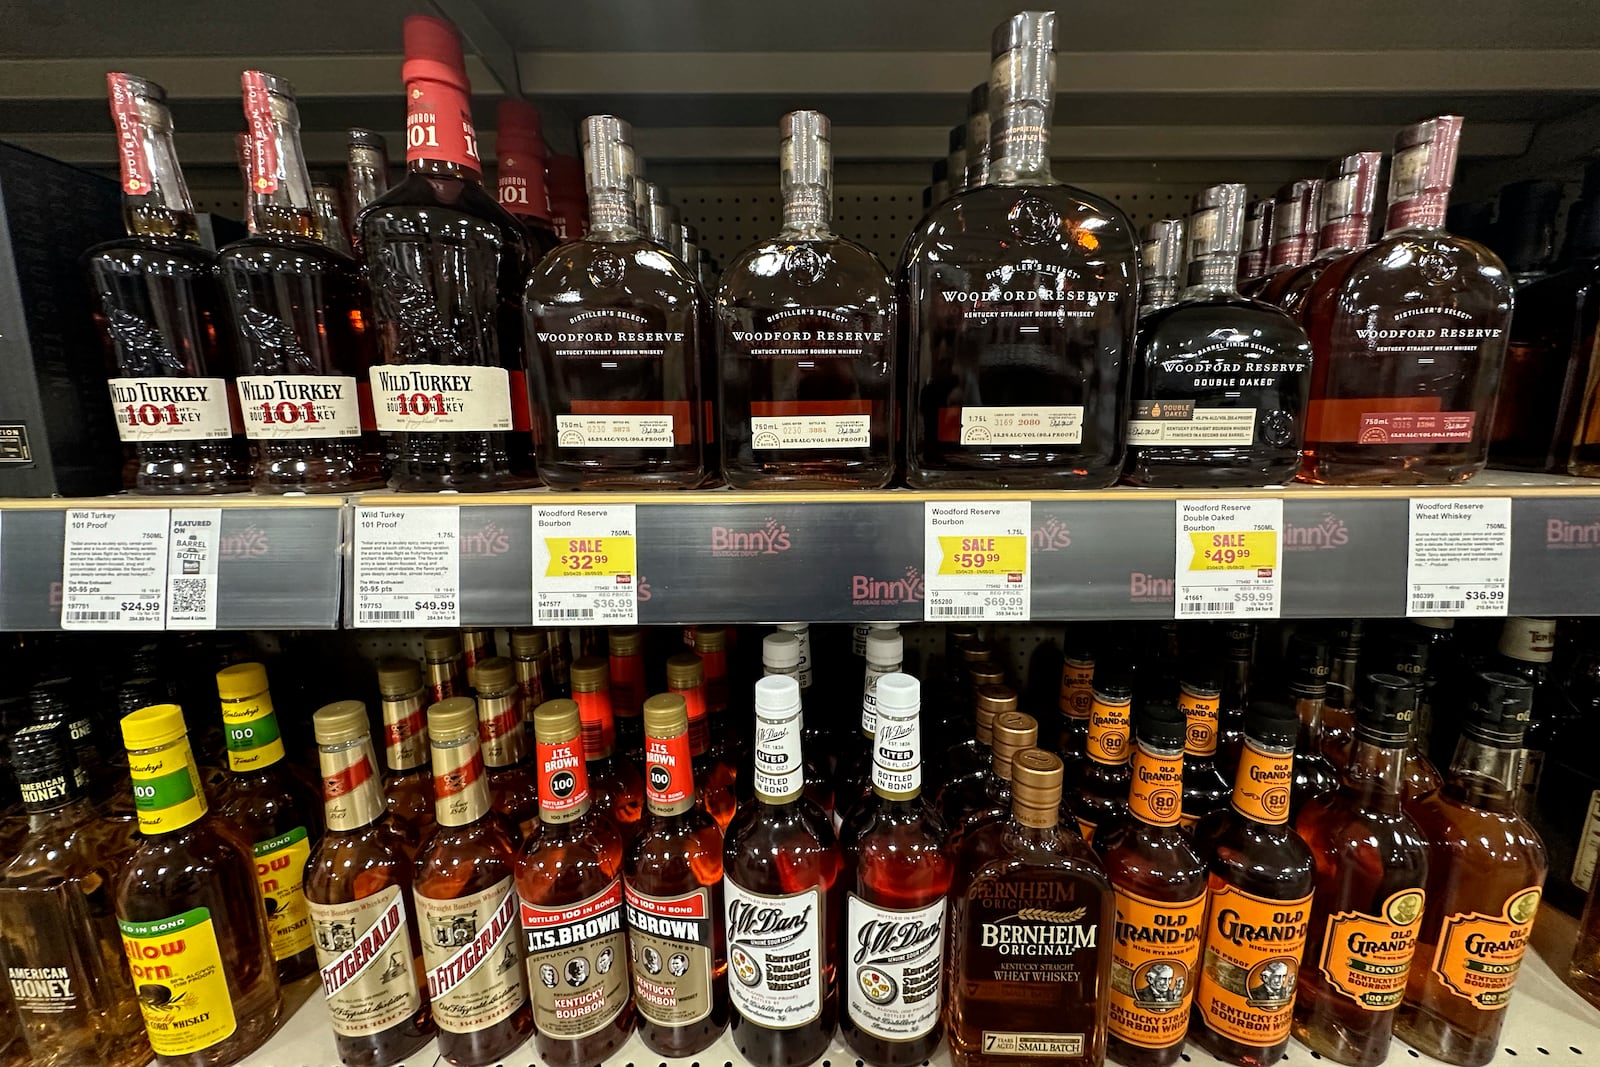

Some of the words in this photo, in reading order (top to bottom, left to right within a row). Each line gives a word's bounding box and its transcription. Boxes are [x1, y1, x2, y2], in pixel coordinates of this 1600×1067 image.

[499, 186, 528, 204] 101
[942, 291, 1037, 302] WOODFORD
[1046, 291, 1118, 302] RESERVE
[570, 310, 614, 325] DISTILLER'S
[767, 309, 814, 323] DISTILLER'S
[1394, 307, 1441, 321] DISTILLER'S
[537, 332, 612, 342] WOODFORD
[618, 332, 684, 342] RESERVE
[732, 331, 811, 341] WOODFORD
[817, 331, 883, 341] RESERVE
[1356, 329, 1435, 338] WOODFORD
[1440, 329, 1502, 338] RESERVE
[1198, 343, 1224, 355] BARREL
[1250, 343, 1274, 355] SELECT
[1162, 363, 1241, 372] WOODFORD
[1246, 363, 1305, 372] RESERVE
[379, 372, 409, 391] WILD
[409, 372, 473, 392] TURKEY
[1240, 378, 1275, 386] OAKED
[108, 383, 137, 401] WILD
[136, 383, 210, 403] TURKEY
[241, 381, 273, 401] WILD
[273, 380, 344, 401] TURKEY
[397, 393, 448, 415] 101
[125, 404, 183, 426] 101
[260, 401, 320, 424] 101
[91, 512, 116, 520] Turkey
[569, 540, 602, 552] SALE
[962, 539, 995, 551] SALE
[1213, 535, 1245, 547] SALE
[984, 597, 1023, 606] $69.99
[1234, 593, 1273, 602] $59.99
[1466, 591, 1504, 600] $36.99
[121, 602, 160, 611] $24.99
[415, 601, 455, 610] $49.99
[593, 600, 632, 608] $36.99
[231, 728, 253, 740] 100
[1192, 730, 1207, 739] 80
[1106, 739, 1121, 747] 80
[882, 747, 911, 759] LITER
[545, 757, 579, 773] BROWN
[651, 773, 668, 782] 100
[878, 770, 913, 782] BOTTLED
[20, 775, 65, 791] AMERICAN
[553, 778, 573, 791] 100
[764, 784, 789, 793] BOND
[877, 778, 886, 788] IN
[888, 781, 913, 790] BOND
[22, 783, 67, 803] HONEY
[134, 786, 155, 798] 100
[1156, 798, 1174, 808] 80
[1269, 796, 1286, 805] 80
[262, 836, 290, 851] BOND
[640, 899, 654, 908] 100
[528, 914, 560, 923] BOTTLED
[562, 910, 581, 920] 100
[595, 897, 615, 908] BOND
[1153, 914, 1187, 926] OLD
[1273, 911, 1304, 924] OLD
[151, 919, 185, 932] BOND
[981, 923, 1097, 948] BERNHEIM
[1391, 930, 1412, 940] OLD
[321, 904, 400, 996] FITZGERALD
[437, 895, 515, 997] FITZGERALD
[998, 944, 1075, 956] ORIGINAL
[765, 949, 811, 963] KENTUCKY
[765, 958, 811, 972] STRAIGHT
[1040, 963, 1074, 971] STRAIGHT
[8, 967, 69, 980] AMERICAN
[766, 968, 811, 981] BOURBON
[993, 971, 1030, 981] WHEAT
[1032, 972, 1080, 982] WHISKEY
[1349, 971, 1393, 983] KENTUCKY
[11, 978, 72, 999] HONEY
[637, 975, 675, 995] KENTUCKY
[767, 977, 811, 991] WHISKEY
[1348, 978, 1392, 990] BOURBON
[1464, 978, 1508, 989] BOURBON
[554, 986, 604, 1008] KENTUCKY
[556, 999, 605, 1019] BOURBON
[1212, 998, 1270, 1023] KENTUCKY
[173, 1012, 210, 1029] WHISKEY
[1210, 1007, 1270, 1031] BOURBON
[986, 1035, 996, 1050] 7
[1018, 1043, 1048, 1052] SMALL
[1050, 1043, 1080, 1052] BATCH
